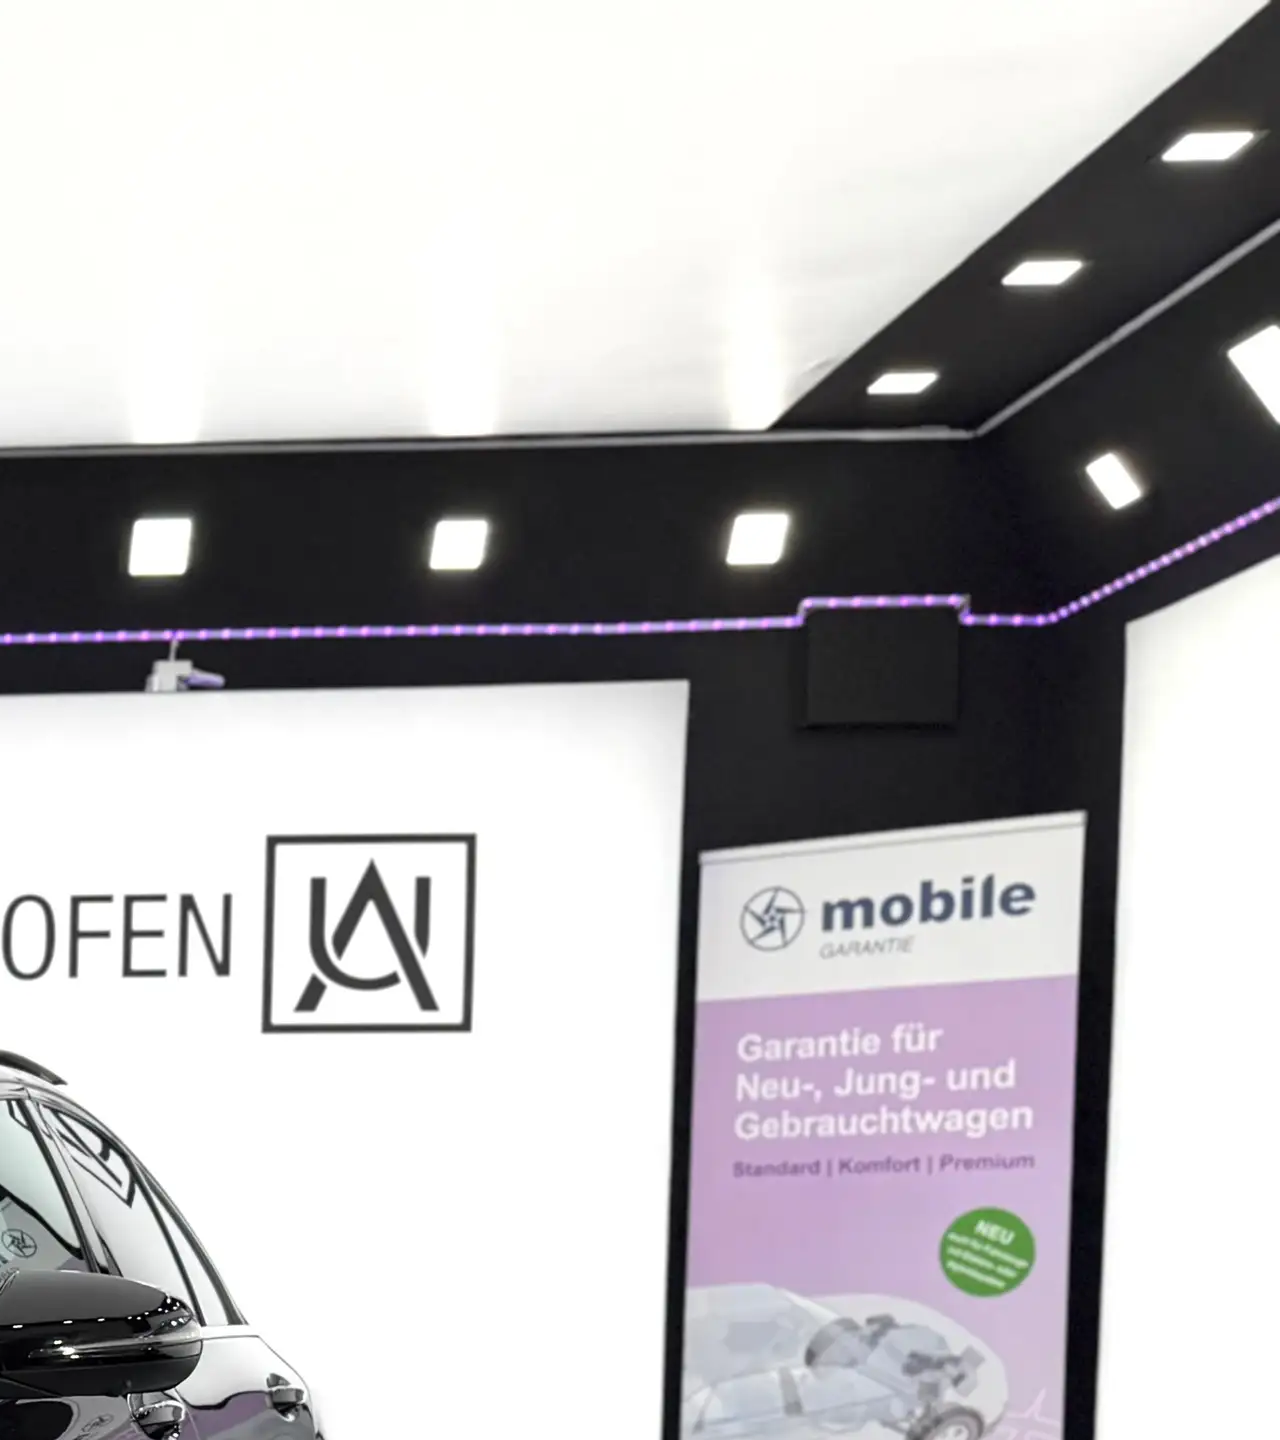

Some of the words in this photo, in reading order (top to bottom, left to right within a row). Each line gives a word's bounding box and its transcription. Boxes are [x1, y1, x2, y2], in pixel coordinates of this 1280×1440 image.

[821, 873, 1036, 932] mobile
[820, 935, 916, 959] GARANTIE
[737, 1027, 881, 1063] Garantie
[890, 1021, 943, 1055] für
[736, 1071, 822, 1102] Neu-,
[834, 1067, 936, 1100] Jung-
[947, 1058, 1016, 1091] und
[734, 1104, 1034, 1141] Gebrauchtwagen
[733, 1159, 822, 1179] Standard
[838, 1156, 921, 1175] Komfort
[940, 1153, 1036, 1172] Premium
[975, 1219, 1016, 1246] NEU
